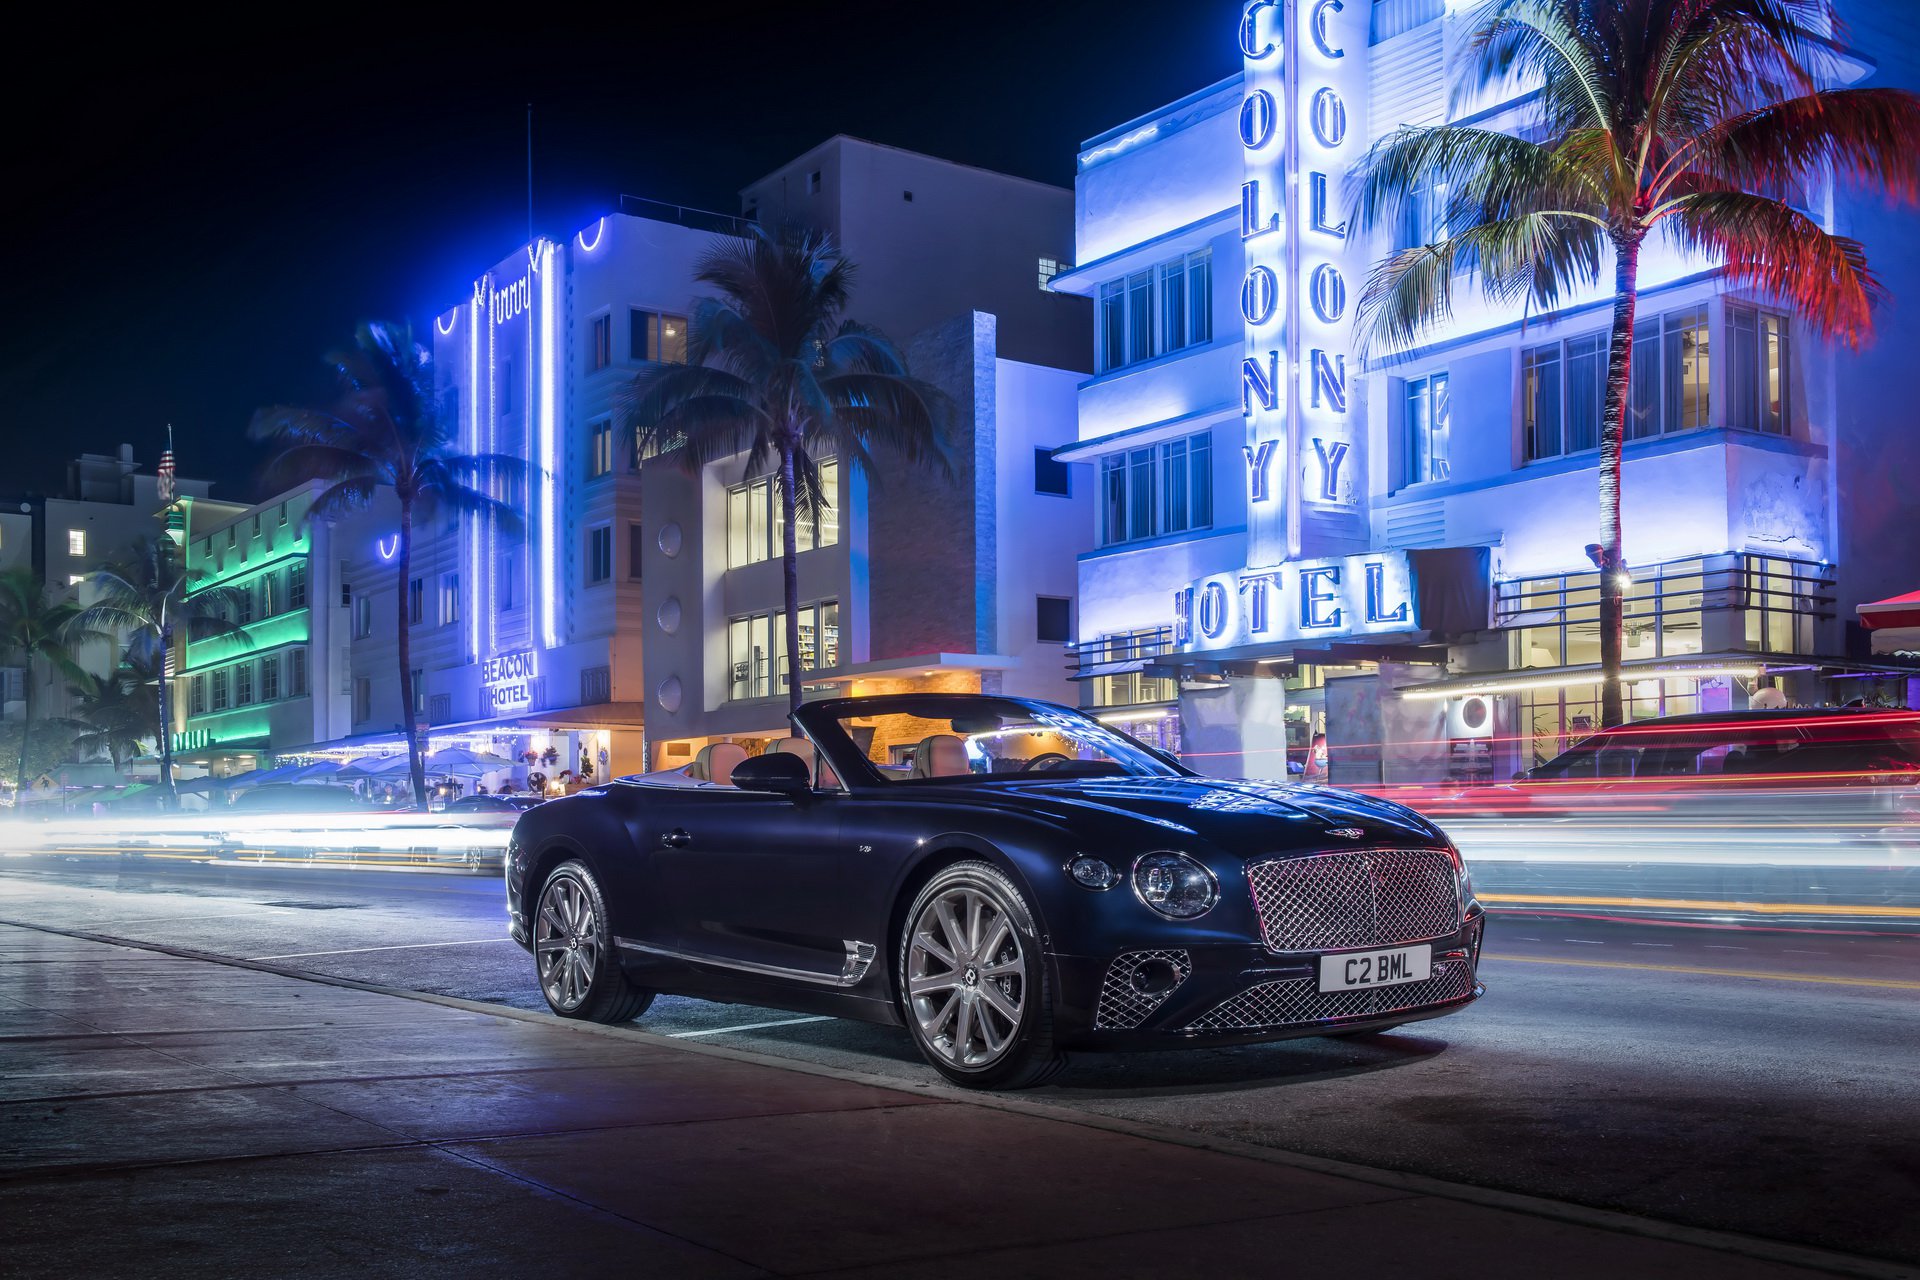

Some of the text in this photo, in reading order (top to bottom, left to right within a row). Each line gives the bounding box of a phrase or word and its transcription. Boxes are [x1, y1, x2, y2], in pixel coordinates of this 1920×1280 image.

[1238, 0, 1280, 502] COLONY
[1309, 0, 1350, 501] COLONY
[1172, 563, 1408, 647] HOTEL
[482, 653, 534, 683] BEACON
[491, 685, 529, 705] HOTEL
[1345, 953, 1412, 985] C2 BML
